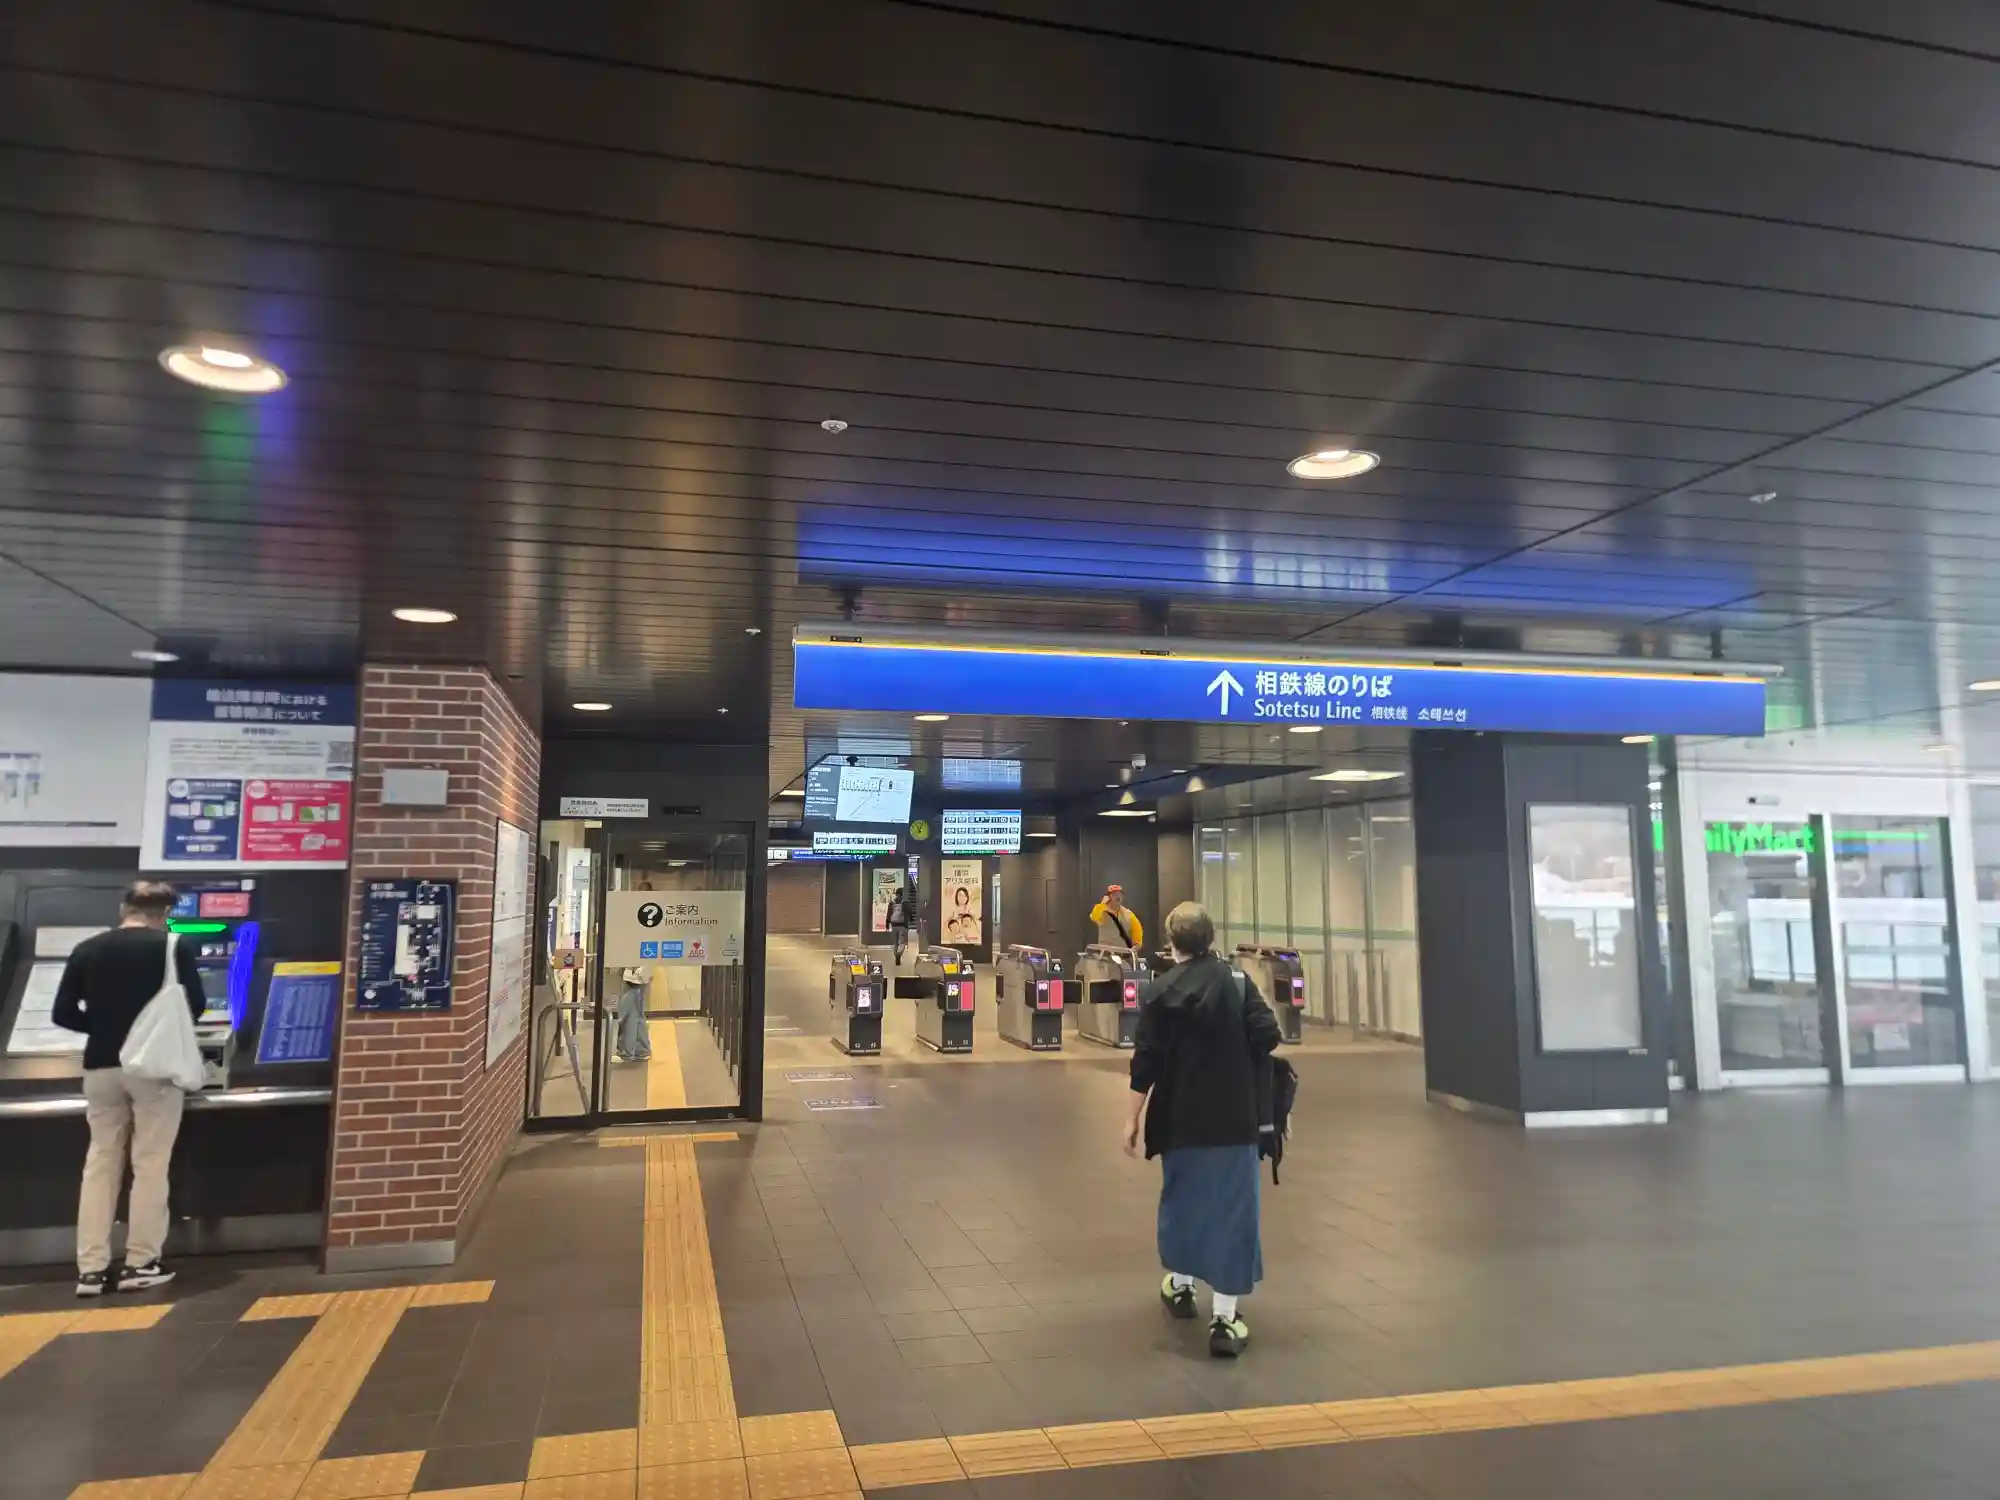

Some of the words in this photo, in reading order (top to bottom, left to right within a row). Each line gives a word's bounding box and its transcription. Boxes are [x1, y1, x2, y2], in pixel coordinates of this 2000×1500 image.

[1255, 670, 1393, 698] 相鉄線のりば
[1254, 698, 1320, 719] Sotetsu
[1326, 700, 1361, 720] Line
[1417, 706, 1467, 723] 소테쓰선
[665, 904, 699, 916] ご案内
[665, 917, 718, 926] Information
[873, 966, 881, 974] 2
[963, 965, 972, 974] 3
